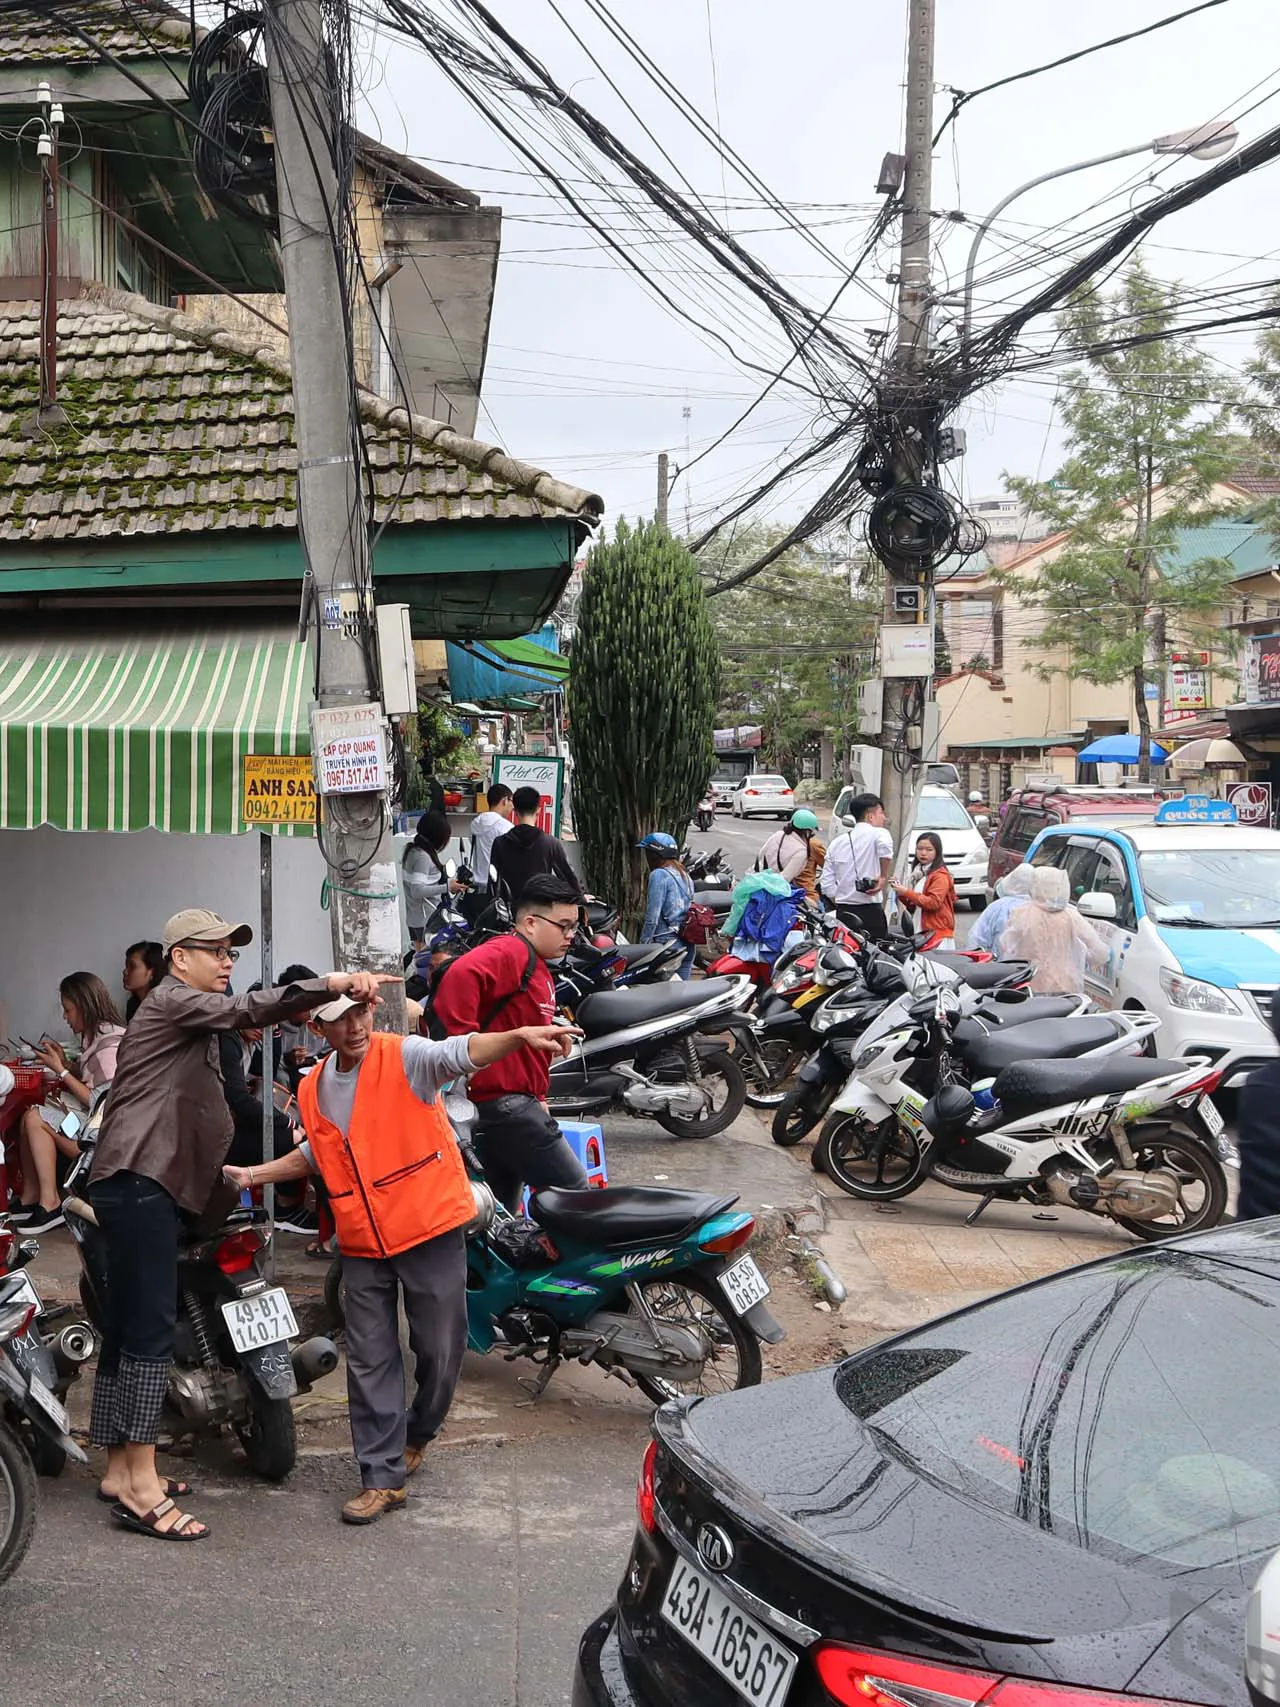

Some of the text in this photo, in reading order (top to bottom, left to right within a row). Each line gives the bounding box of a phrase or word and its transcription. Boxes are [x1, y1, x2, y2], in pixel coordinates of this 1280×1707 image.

[354, 740, 376, 755] QUANG
[369, 755, 378, 765] HD
[248, 779, 283, 796] ANH
[326, 766, 378, 787] 0967.517.417
[1164, 808, 1208, 821] QUỐC
[621, 1247, 682, 1270] Wave
[726, 1260, 755, 1291] 49-S6
[736, 1279, 766, 1310] 0854
[235, 1295, 280, 1325] 49-B1
[236, 1314, 294, 1348] 140.71
[699, 1526, 722, 1566] KIA
[667, 1566, 789, 1707] 43A-165.67
